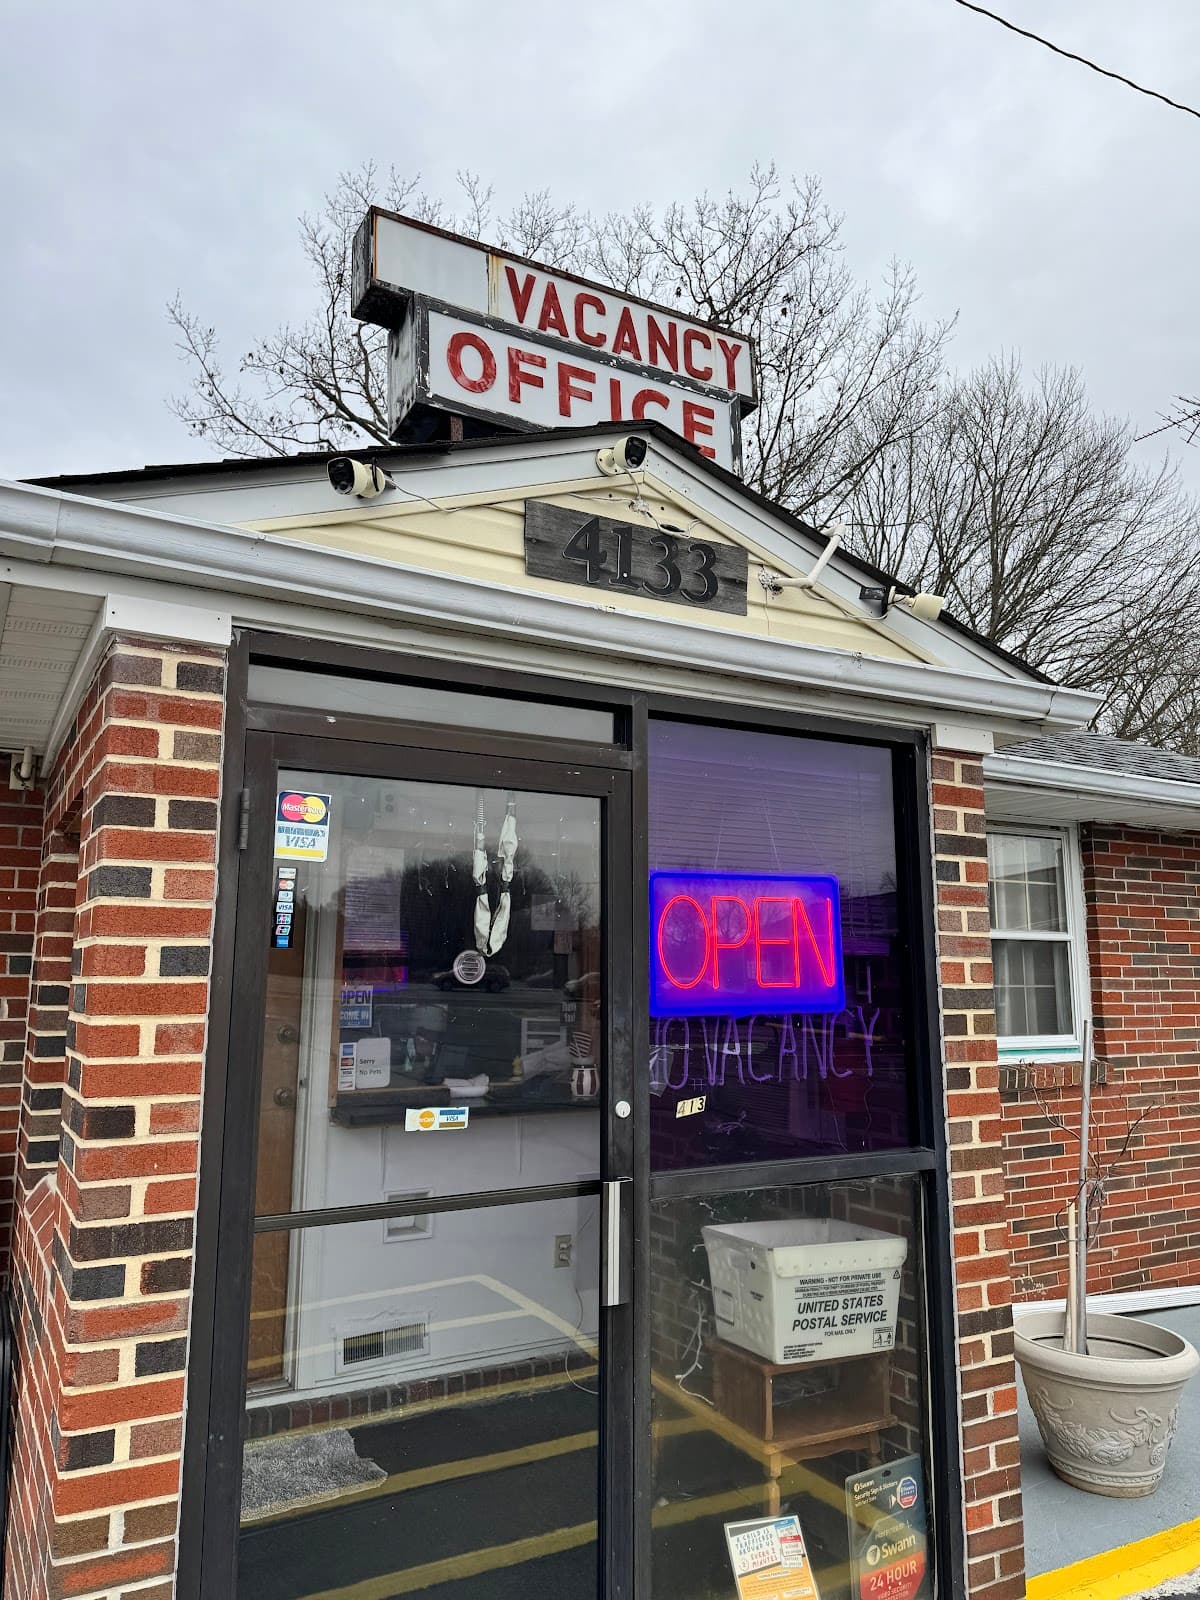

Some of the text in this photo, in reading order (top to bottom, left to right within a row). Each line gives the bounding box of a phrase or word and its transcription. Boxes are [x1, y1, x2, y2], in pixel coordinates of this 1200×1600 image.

[504, 265, 742, 390] VACANCY
[562, 517, 719, 602] 4133
[286, 835, 316, 848] VISA
[657, 894, 836, 990] OPEN
[340, 990, 371, 1005] OPEN
[702, 1006, 880, 1087] VACANCY
[797, 1294, 884, 1314] UNITED STATES
[792, 1310, 887, 1331] POSTAL SERVICE
[742, 1530, 761, 1540] CHILD
[881, 1534, 916, 1559] Swann
[752, 1555, 778, 1568] MINUTES
[870, 1560, 918, 1591] 24 HOUR
